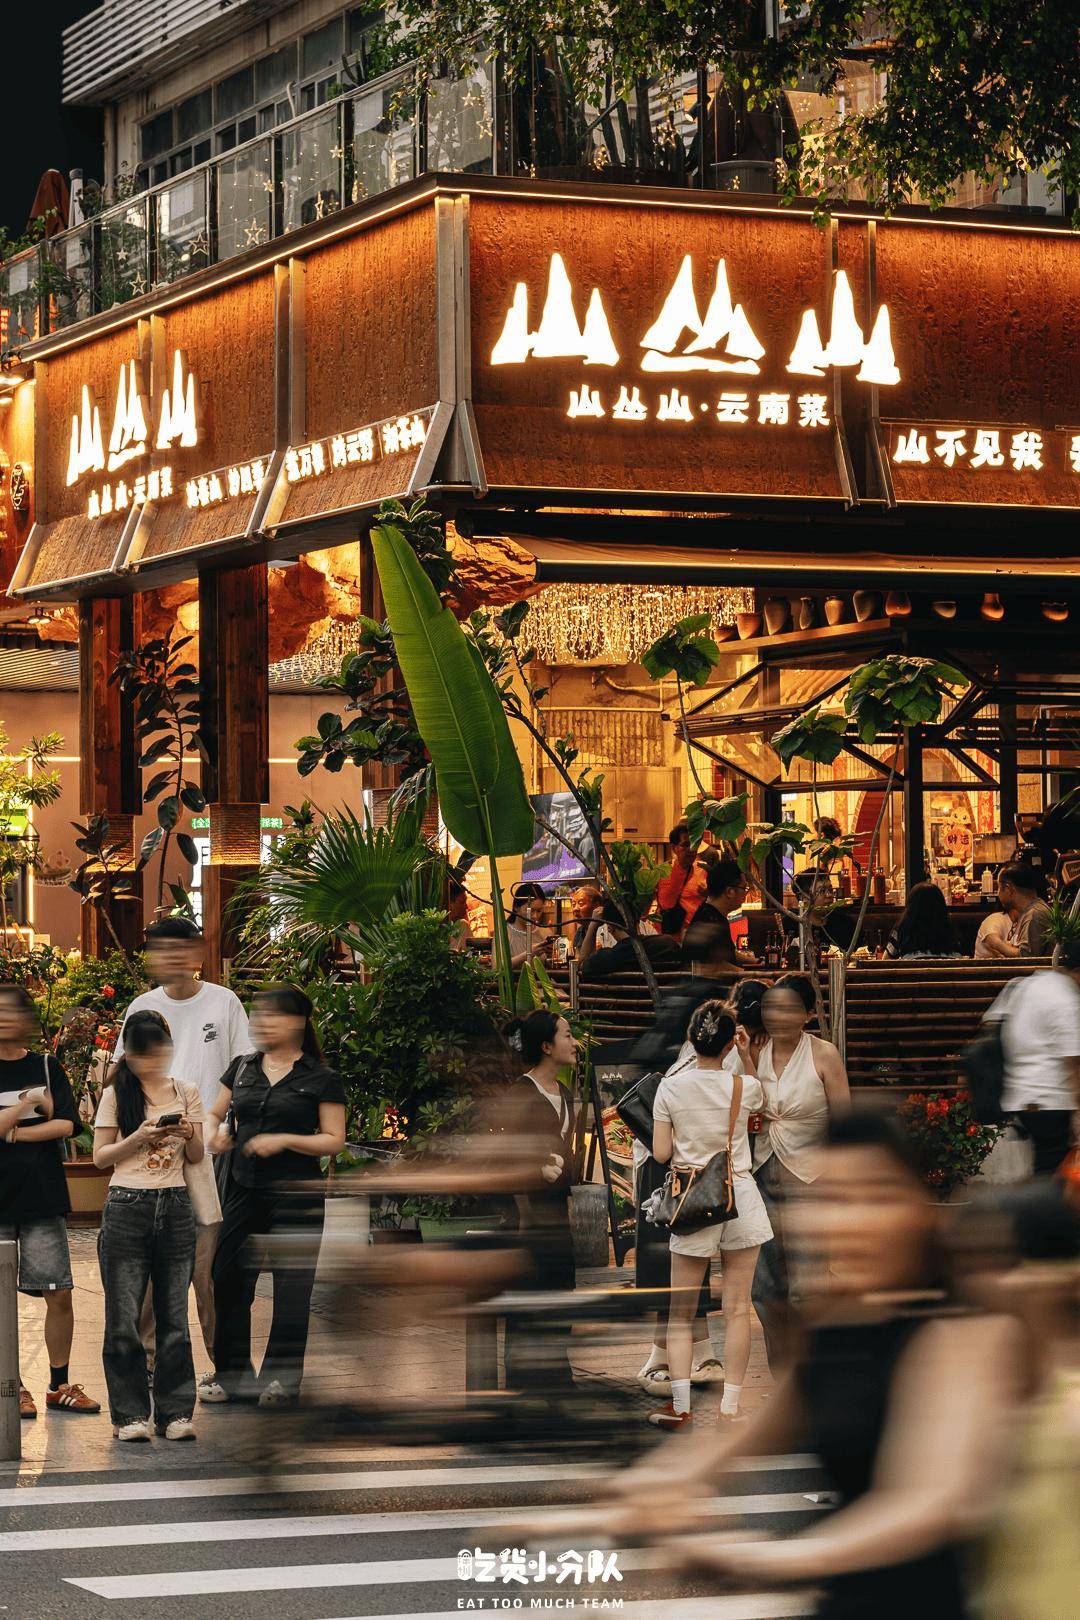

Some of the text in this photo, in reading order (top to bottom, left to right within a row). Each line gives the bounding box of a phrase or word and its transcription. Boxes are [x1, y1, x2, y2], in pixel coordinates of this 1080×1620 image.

[490, 252, 901, 386] 山丛山
[66, 349, 198, 487] 山丛山
[892, 428, 1044, 470] 山不见我
